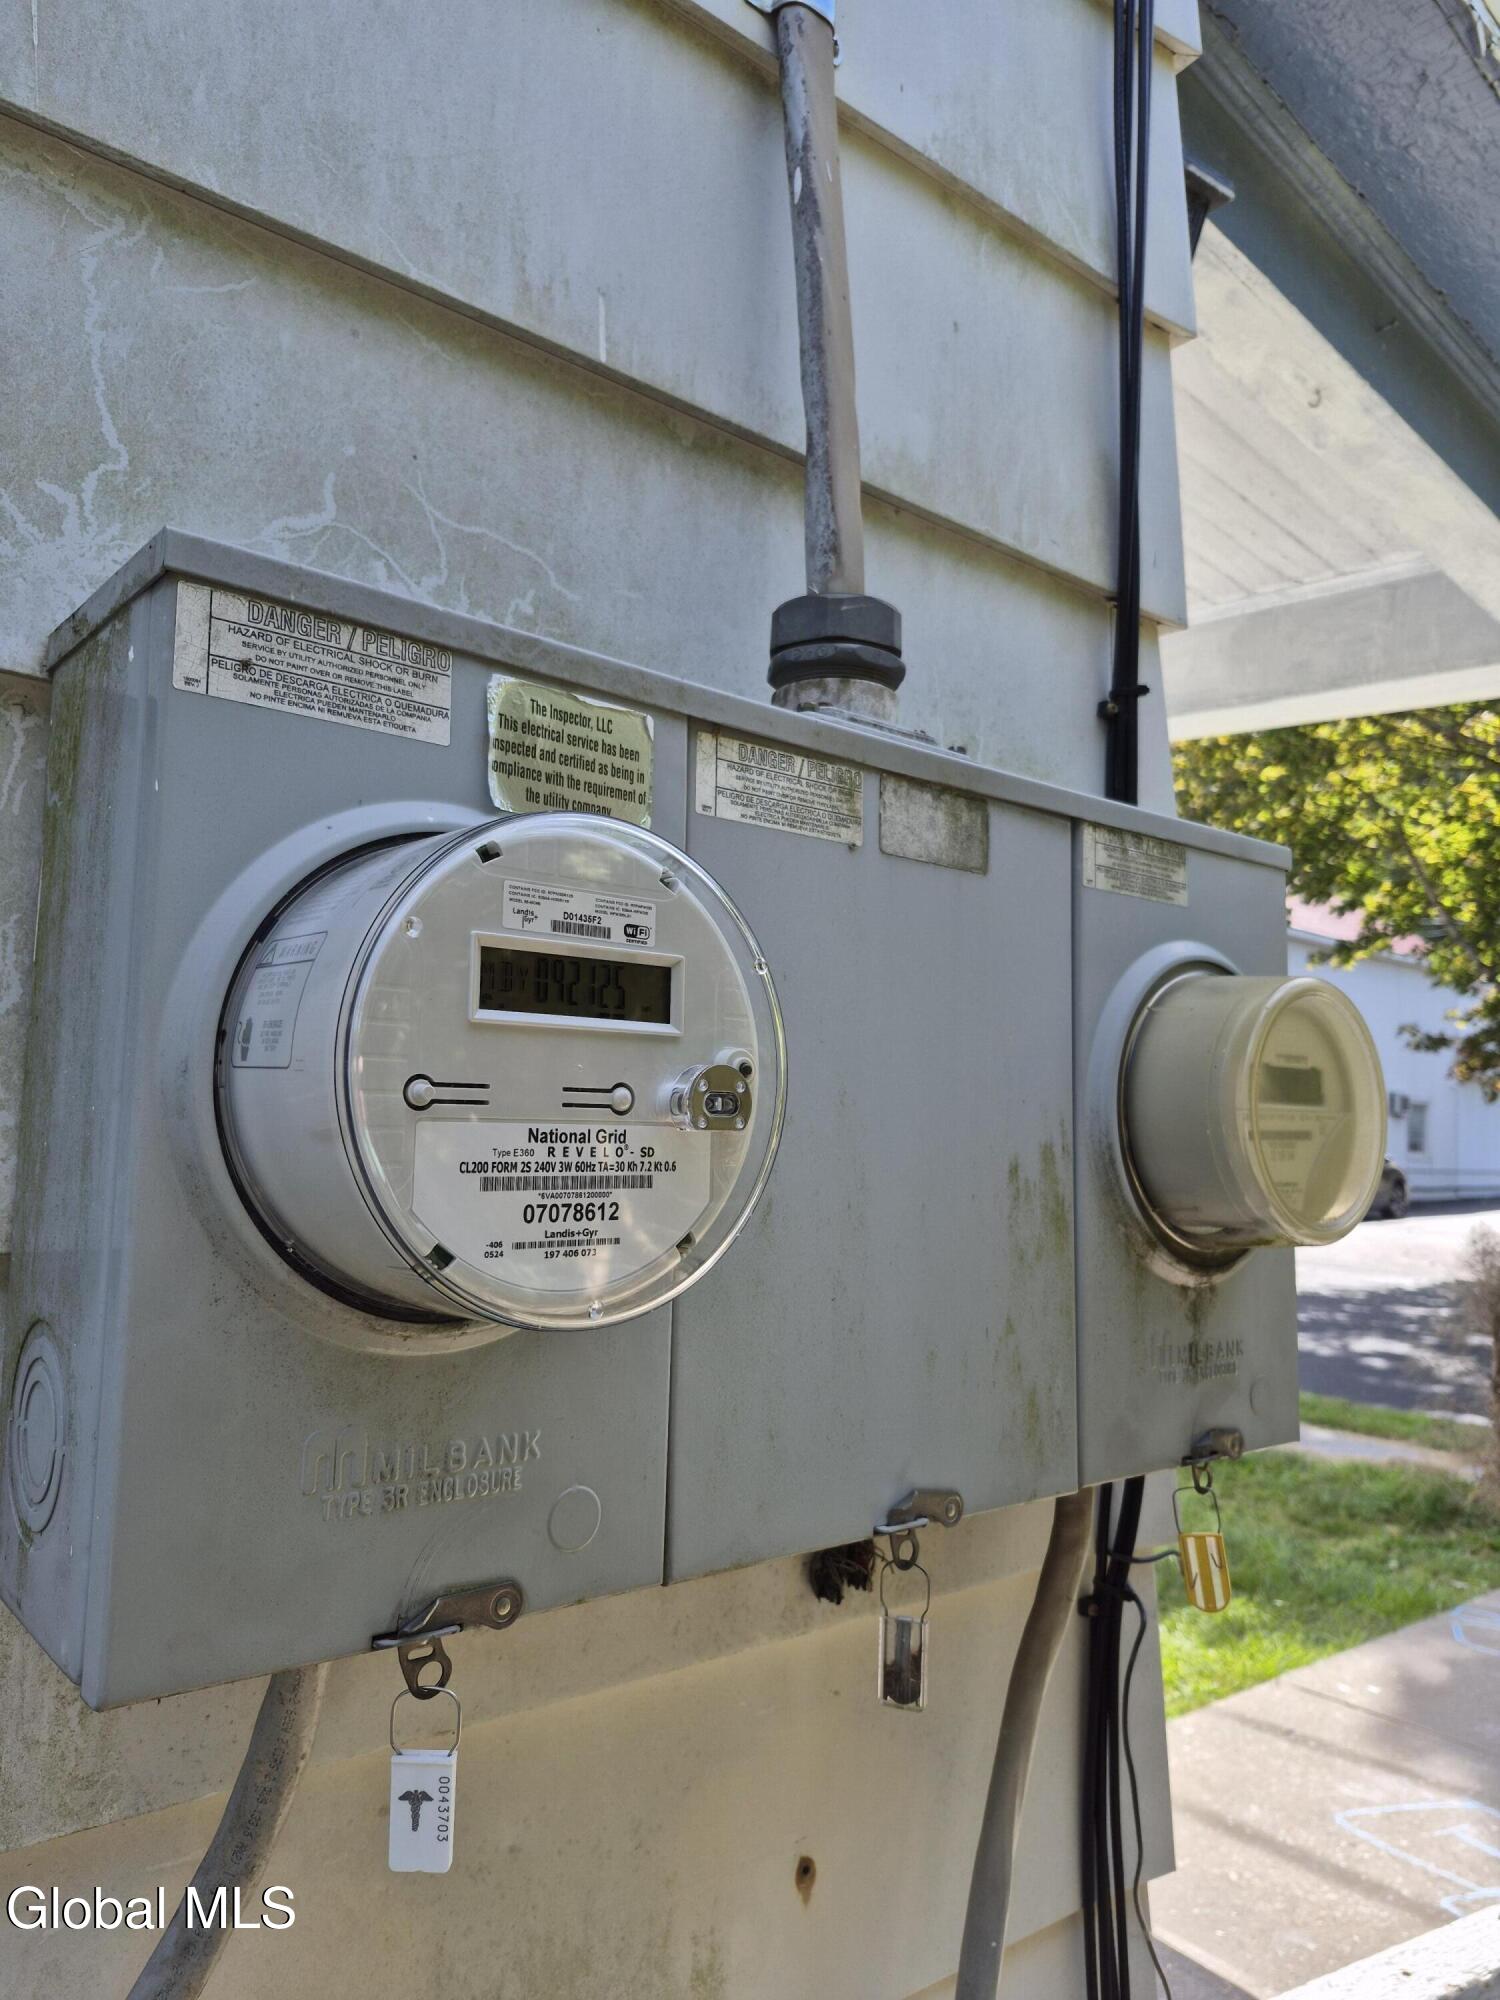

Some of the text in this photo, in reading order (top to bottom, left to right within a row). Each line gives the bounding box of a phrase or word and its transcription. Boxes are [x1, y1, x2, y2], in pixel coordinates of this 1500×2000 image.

[228, 624, 438, 683] HAZARD OF ELECTRICAL SHOCK OR BURN
[248, 601, 341, 644] DANGER
[362, 630, 450, 672] PELIGRO
[241, 640, 275, 653] SERVICE
[289, 651, 316, 663] UTILITY
[317, 659, 364, 675] AUTHORIZED
[365, 670, 406, 685] PERSONNEL
[408, 681, 426, 690] ONLY
[269, 657, 284, 667] NOT
[286, 662, 308, 672] PAINT
[310, 668, 331, 678] OVER
[345, 675, 374, 688] REMOVE
[377, 682, 392, 691] THIS
[393, 687, 414, 697] LABEL
[211, 658, 449, 720] PELIGRO DE DESCARGA ELECTRICA O QUEMADURA
[233, 672, 279, 689] SOLAMENTE
[281, 684, 322, 698] PERSONAS
[323, 693, 373, 709] AUTORIZADAS
[396, 709, 432, 722] COMPANIA
[273, 690, 315, 704] ELECTRICA
[317, 700, 347, 711] PUEDEN
[263, 695, 286, 705] PINTE
[287, 700, 316, 712] ENCIMA
[327, 708, 362, 721] REMUEVA
[363, 717, 381, 725] ESTA
[383, 721, 417, 733] ETIQUETA
[530, 698, 613, 734] The Inspector, LLC
[498, 712, 640, 762] This electrical service has been
[539, 748, 557, 763] and
[558, 752, 596, 773] certified
[598, 762, 608, 775] as
[610, 765, 635, 785] being
[636, 771, 645, 784] in
[739, 743, 795, 774] DANGER
[525, 786, 541, 804] the
[543, 791, 570, 810] utility
[545, 770, 564, 787] with
[567, 774, 581, 791] the
[583, 780, 636, 799] requirement
[638, 791, 647, 806] of
[717, 790, 744, 801] PELIGRO
[512, 907, 535, 916] Landis
[563, 911, 602, 925] D01435F2
[492, 1148, 511, 1158] Type
[513, 1148, 535, 1157] E360
[640, 1147, 655, 1157] SD
[528, 1128, 627, 1144] National Grid
[459, 1160, 677, 1173] CL200 FORM 2S 240V 3W 60Hz TA=30 Kh 7.2 Kt 0.6
[523, 1201, 620, 1224] 07078612
[544, 1227, 599, 1239] Landis+Gyr
[484, 1250, 504, 1259] 0524
[544, 1248, 597, 1259] 197 406 073
[372, 1429, 542, 1484] MILBANK
[321, 1466, 523, 1521] TYPE 3R ENCLOSURE
[436, 1776, 450, 1842] 0043703
